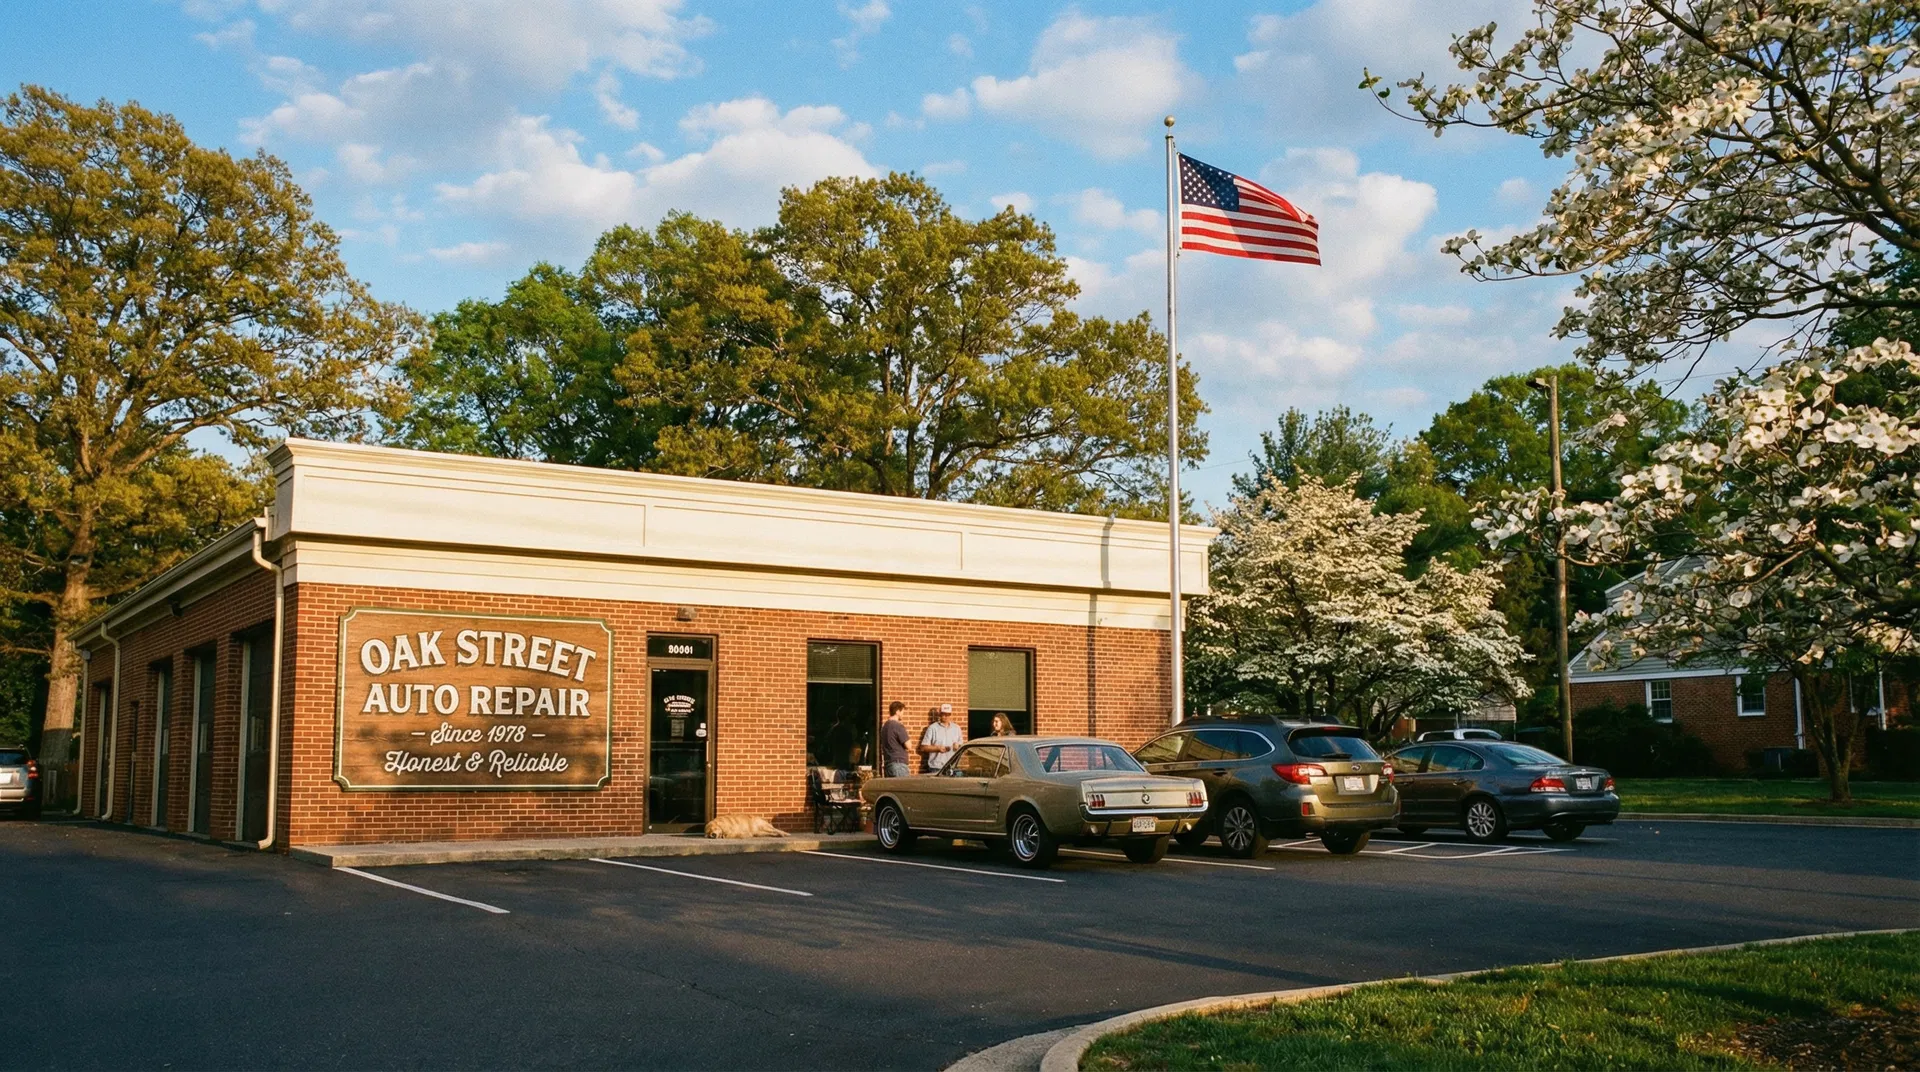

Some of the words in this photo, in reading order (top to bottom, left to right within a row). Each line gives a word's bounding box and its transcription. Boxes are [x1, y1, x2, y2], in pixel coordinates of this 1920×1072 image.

[361, 630, 447, 675] OAK
[456, 629, 597, 682] STREET
[362, 683, 460, 715] AUTO
[469, 685, 591, 717] REPAIR
[430, 722, 483, 746] Since
[487, 725, 527, 743] 1978
[384, 750, 461, 776] Honest
[465, 751, 484, 772] &
[488, 749, 569, 778] Reliable
